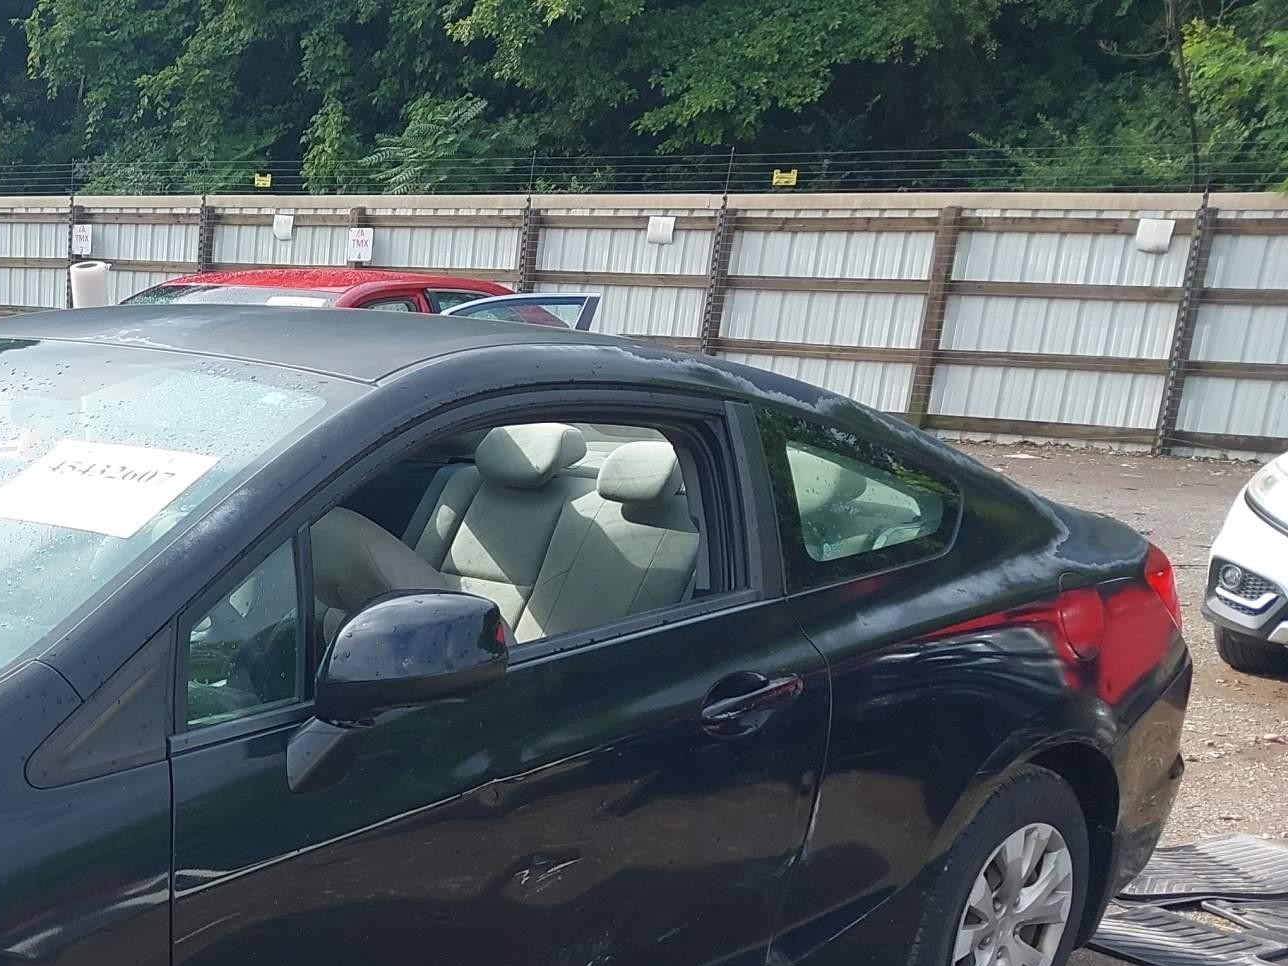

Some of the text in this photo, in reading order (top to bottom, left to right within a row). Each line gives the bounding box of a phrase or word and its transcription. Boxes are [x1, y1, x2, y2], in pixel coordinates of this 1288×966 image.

[75, 234, 89, 242] TMX
[351, 239, 369, 248] TMX
[49, 460, 176, 486] 45432607
